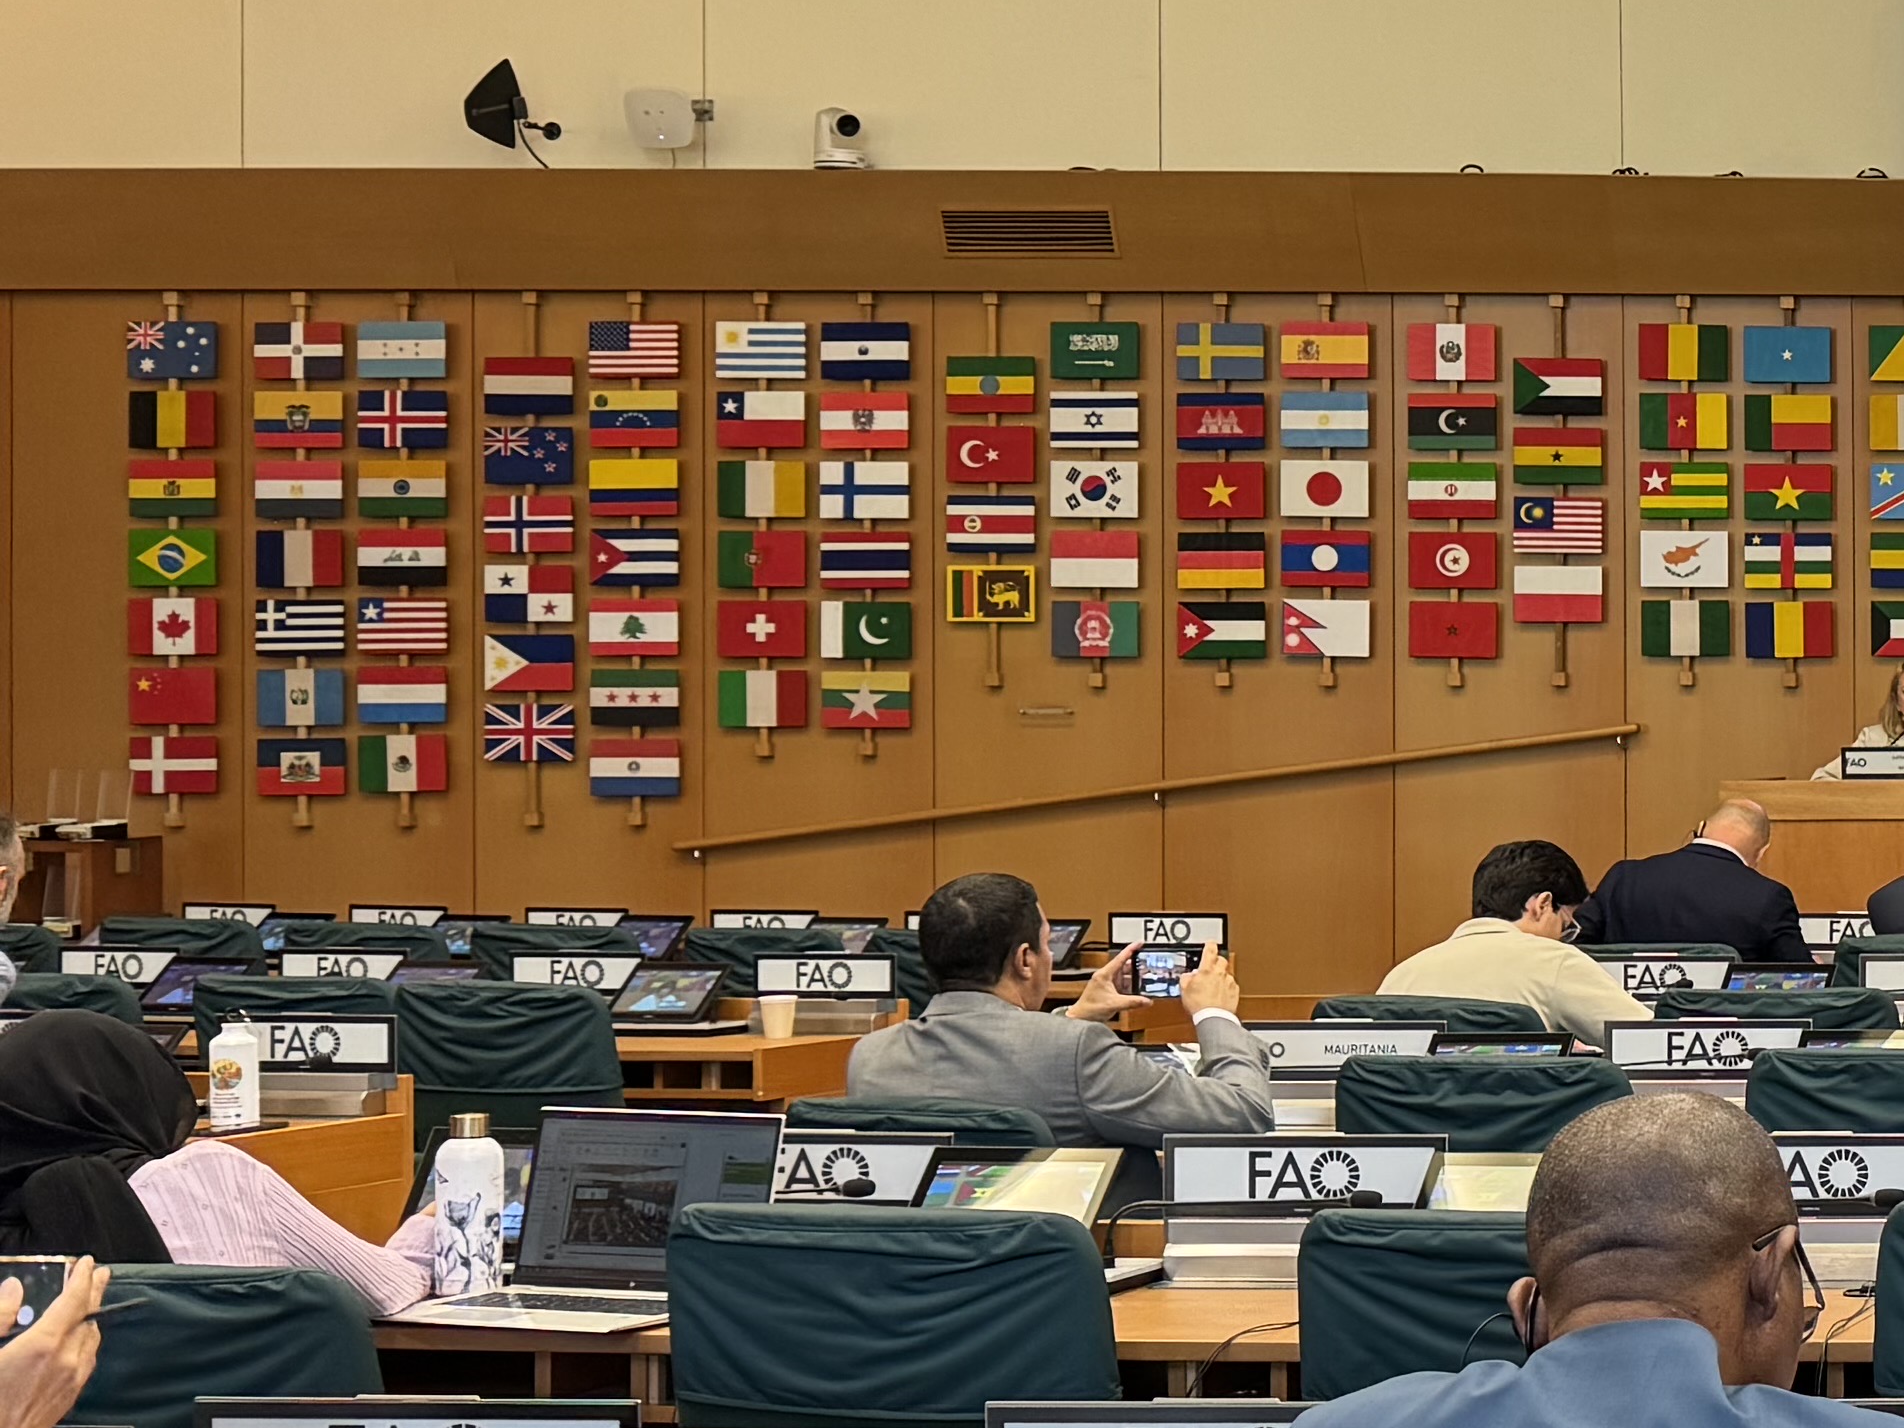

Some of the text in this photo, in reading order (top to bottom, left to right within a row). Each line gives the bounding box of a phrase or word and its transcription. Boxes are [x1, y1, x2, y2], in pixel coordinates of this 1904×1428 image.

[378, 911, 417, 925] FAO
[555, 914, 597, 927] FAO
[743, 915, 786, 929] FAO
[1144, 919, 1191, 943] FAO
[95, 954, 144, 980] FAO
[317, 956, 369, 977] FAO
[550, 958, 605, 988] FAO
[796, 960, 853, 990] FAO
[1624, 962, 1687, 990] FAO
[270, 1024, 341, 1061] FAO
[1324, 1043, 1398, 1056] MAURITANIA
[1667, 1030, 1749, 1067] FAO
[780, 1146, 870, 1196] AO
[1249, 1149, 1361, 1199] FAO
[1787, 1148, 1869, 1199] AO
